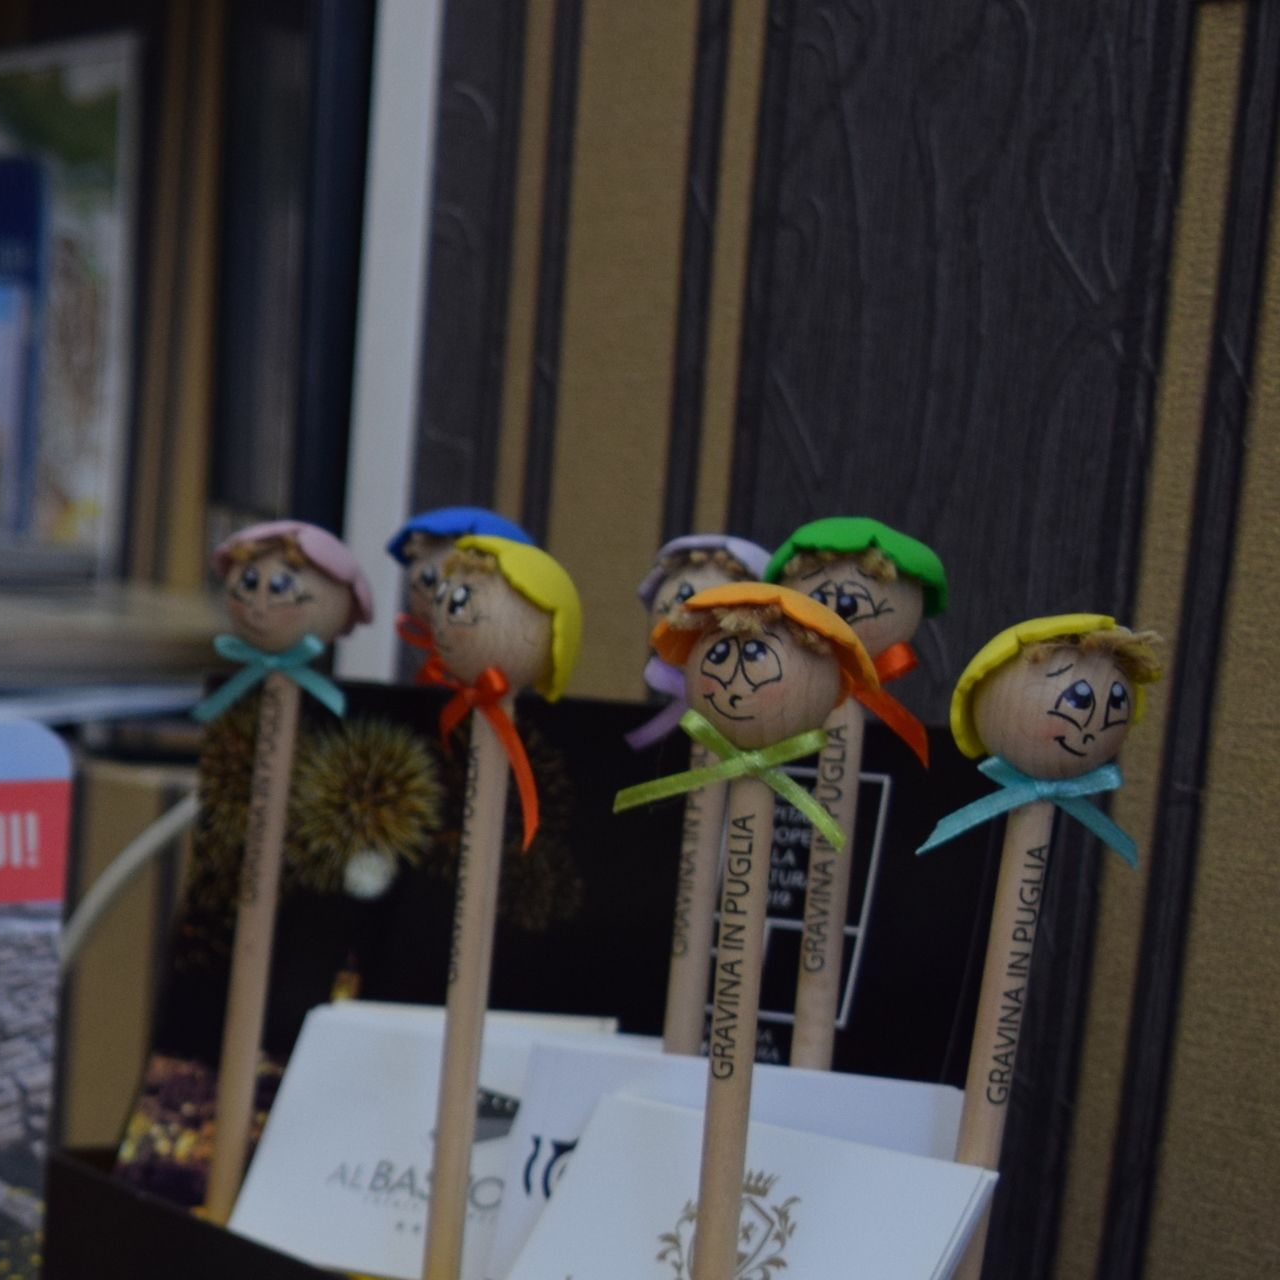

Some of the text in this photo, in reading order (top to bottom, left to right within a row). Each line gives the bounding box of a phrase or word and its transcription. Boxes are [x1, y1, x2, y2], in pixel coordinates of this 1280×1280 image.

[711, 813, 756, 1080] GRAVINA IN PUGLIA
[803, 858, 836, 973] GRAVINA
[986, 844, 1049, 1106] GRAVINA IN PUGLIA
